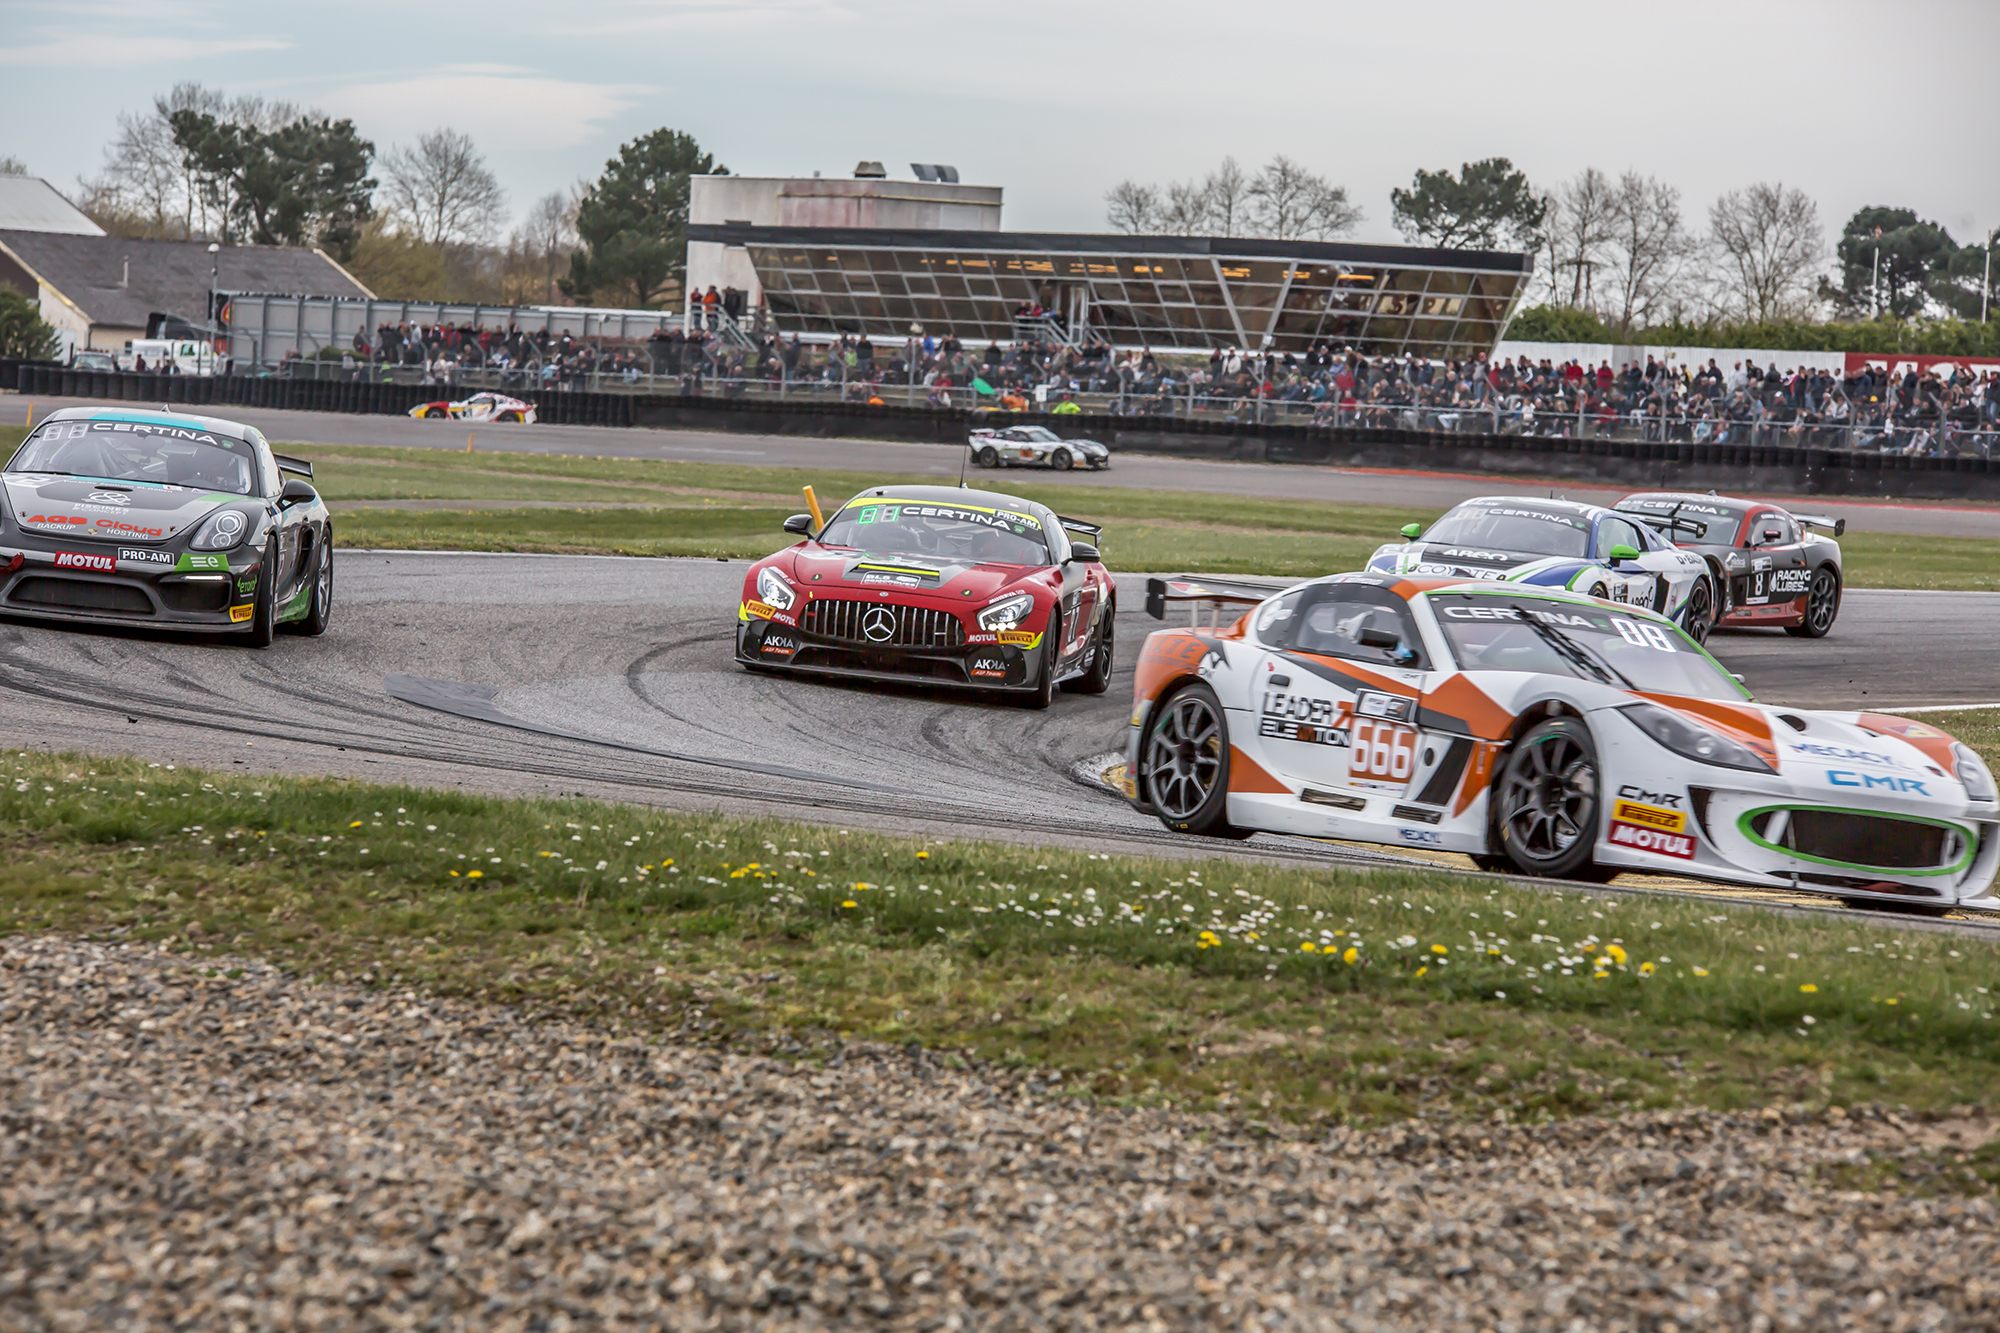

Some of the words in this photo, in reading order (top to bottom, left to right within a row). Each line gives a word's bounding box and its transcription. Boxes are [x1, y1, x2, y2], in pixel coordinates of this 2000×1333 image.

[92, 422, 218, 446] CERTINA
[1643, 500, 1718, 515] CERTINA
[902, 506, 1011, 531] CERTINA
[996, 510, 1038, 529] PRO-AM
[1489, 508, 1573, 526] CERTINA
[37, 522, 76, 531] BACKUP
[96, 519, 163, 537] Cloud
[106, 528, 149, 540] HOSTING
[57, 553, 113, 570] MOTUL
[122, 549, 171, 563] PRO-AM
[1417, 564, 1498, 579] COYTE
[1777, 569, 1812, 581] RACING
[1755, 572, 1764, 596] 8
[747, 602, 773, 616] PIRELLI
[773, 612, 796, 627] MOTUL
[968, 633, 997, 643] MOTUL
[1001, 633, 1032, 644] PIRELLI
[1263, 691, 1333, 725] LEADER
[1826, 769, 1932, 797] CMR
[1616, 784, 1684, 809] CMR
[1613, 825, 1693, 855] MOTUL
